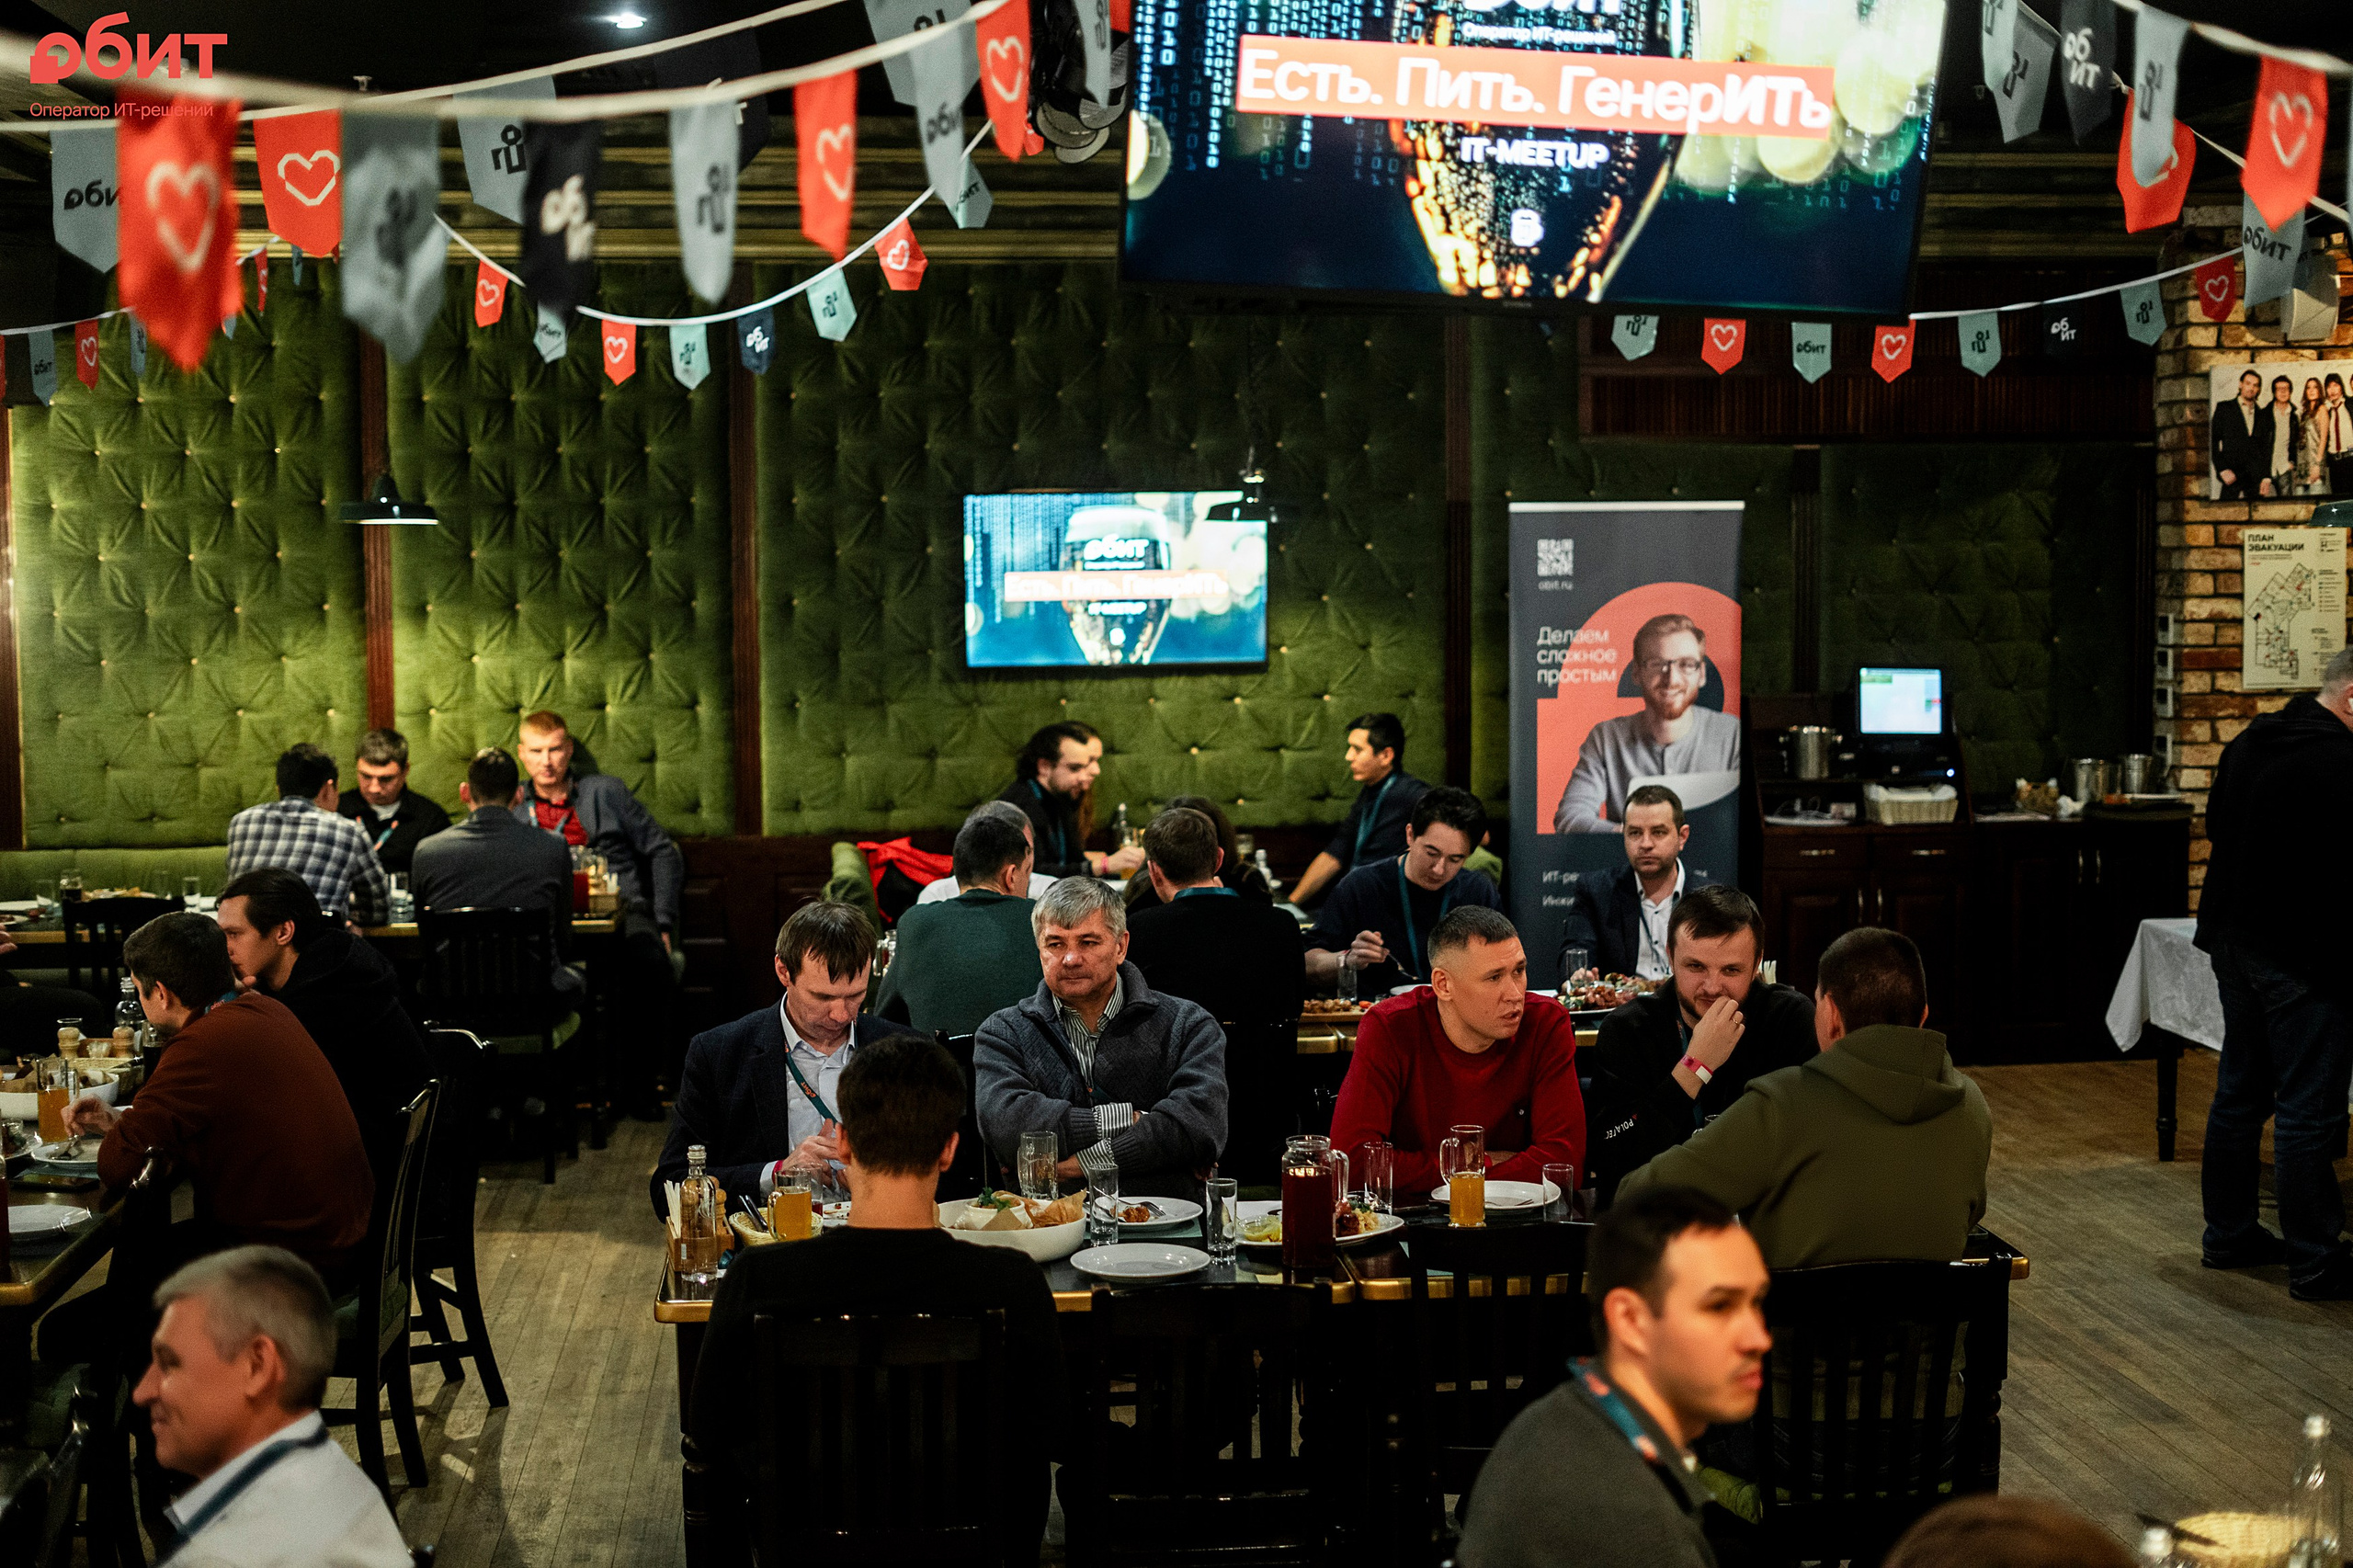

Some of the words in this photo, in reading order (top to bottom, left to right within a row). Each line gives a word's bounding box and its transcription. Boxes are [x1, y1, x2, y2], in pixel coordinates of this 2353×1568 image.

[1240, 48, 1383, 105] Есть.
[1395, 56, 1546, 113] Пить.
[1558, 65, 1832, 135] ГенерИТь
[1461, 135, 1610, 169] IT-MEETUP
[64, 178, 121, 210] оби
[2244, 225, 2292, 261] обит
[2247, 533, 2275, 541] ПЛАН
[2247, 543, 2304, 552] ЭВАКУАЦИИ
[1537, 626, 1609, 646] Делаем
[1537, 648, 1618, 665] сложное
[1537, 668, 1618, 688] простым
[1542, 870, 1580, 884] ИТ-ре
